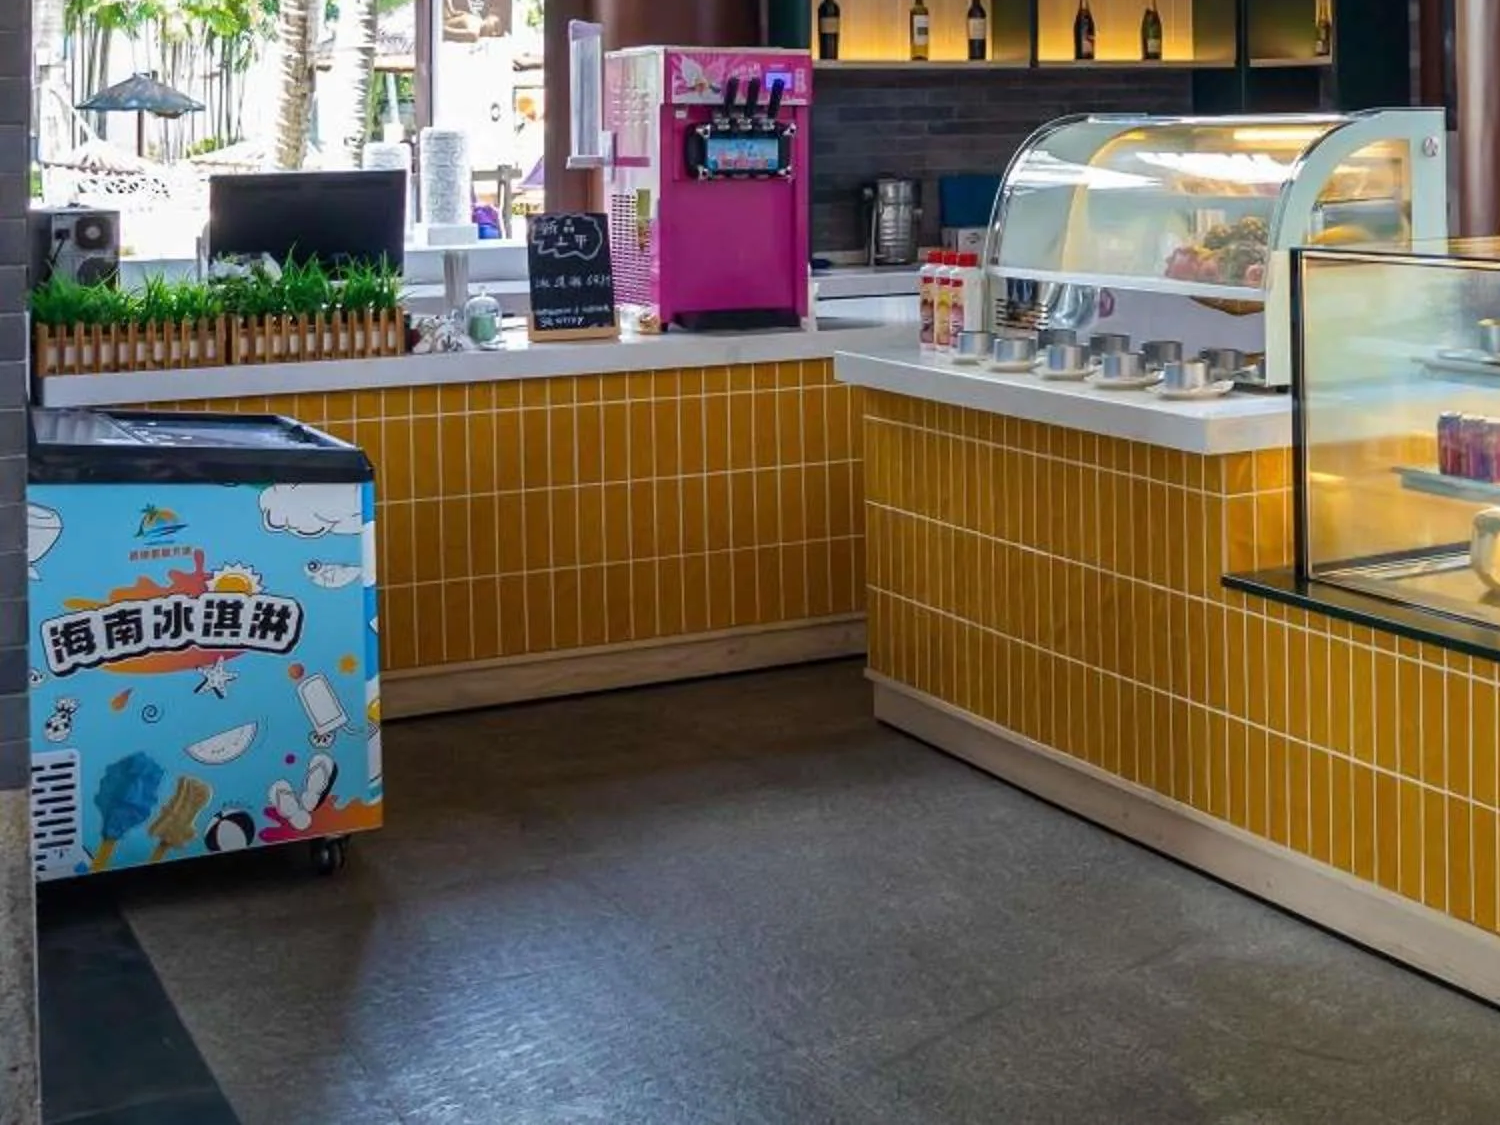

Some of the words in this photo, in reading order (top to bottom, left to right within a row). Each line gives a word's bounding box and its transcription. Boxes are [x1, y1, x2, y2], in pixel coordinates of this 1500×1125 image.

[49, 597, 292, 664] 海南冰淇淋
